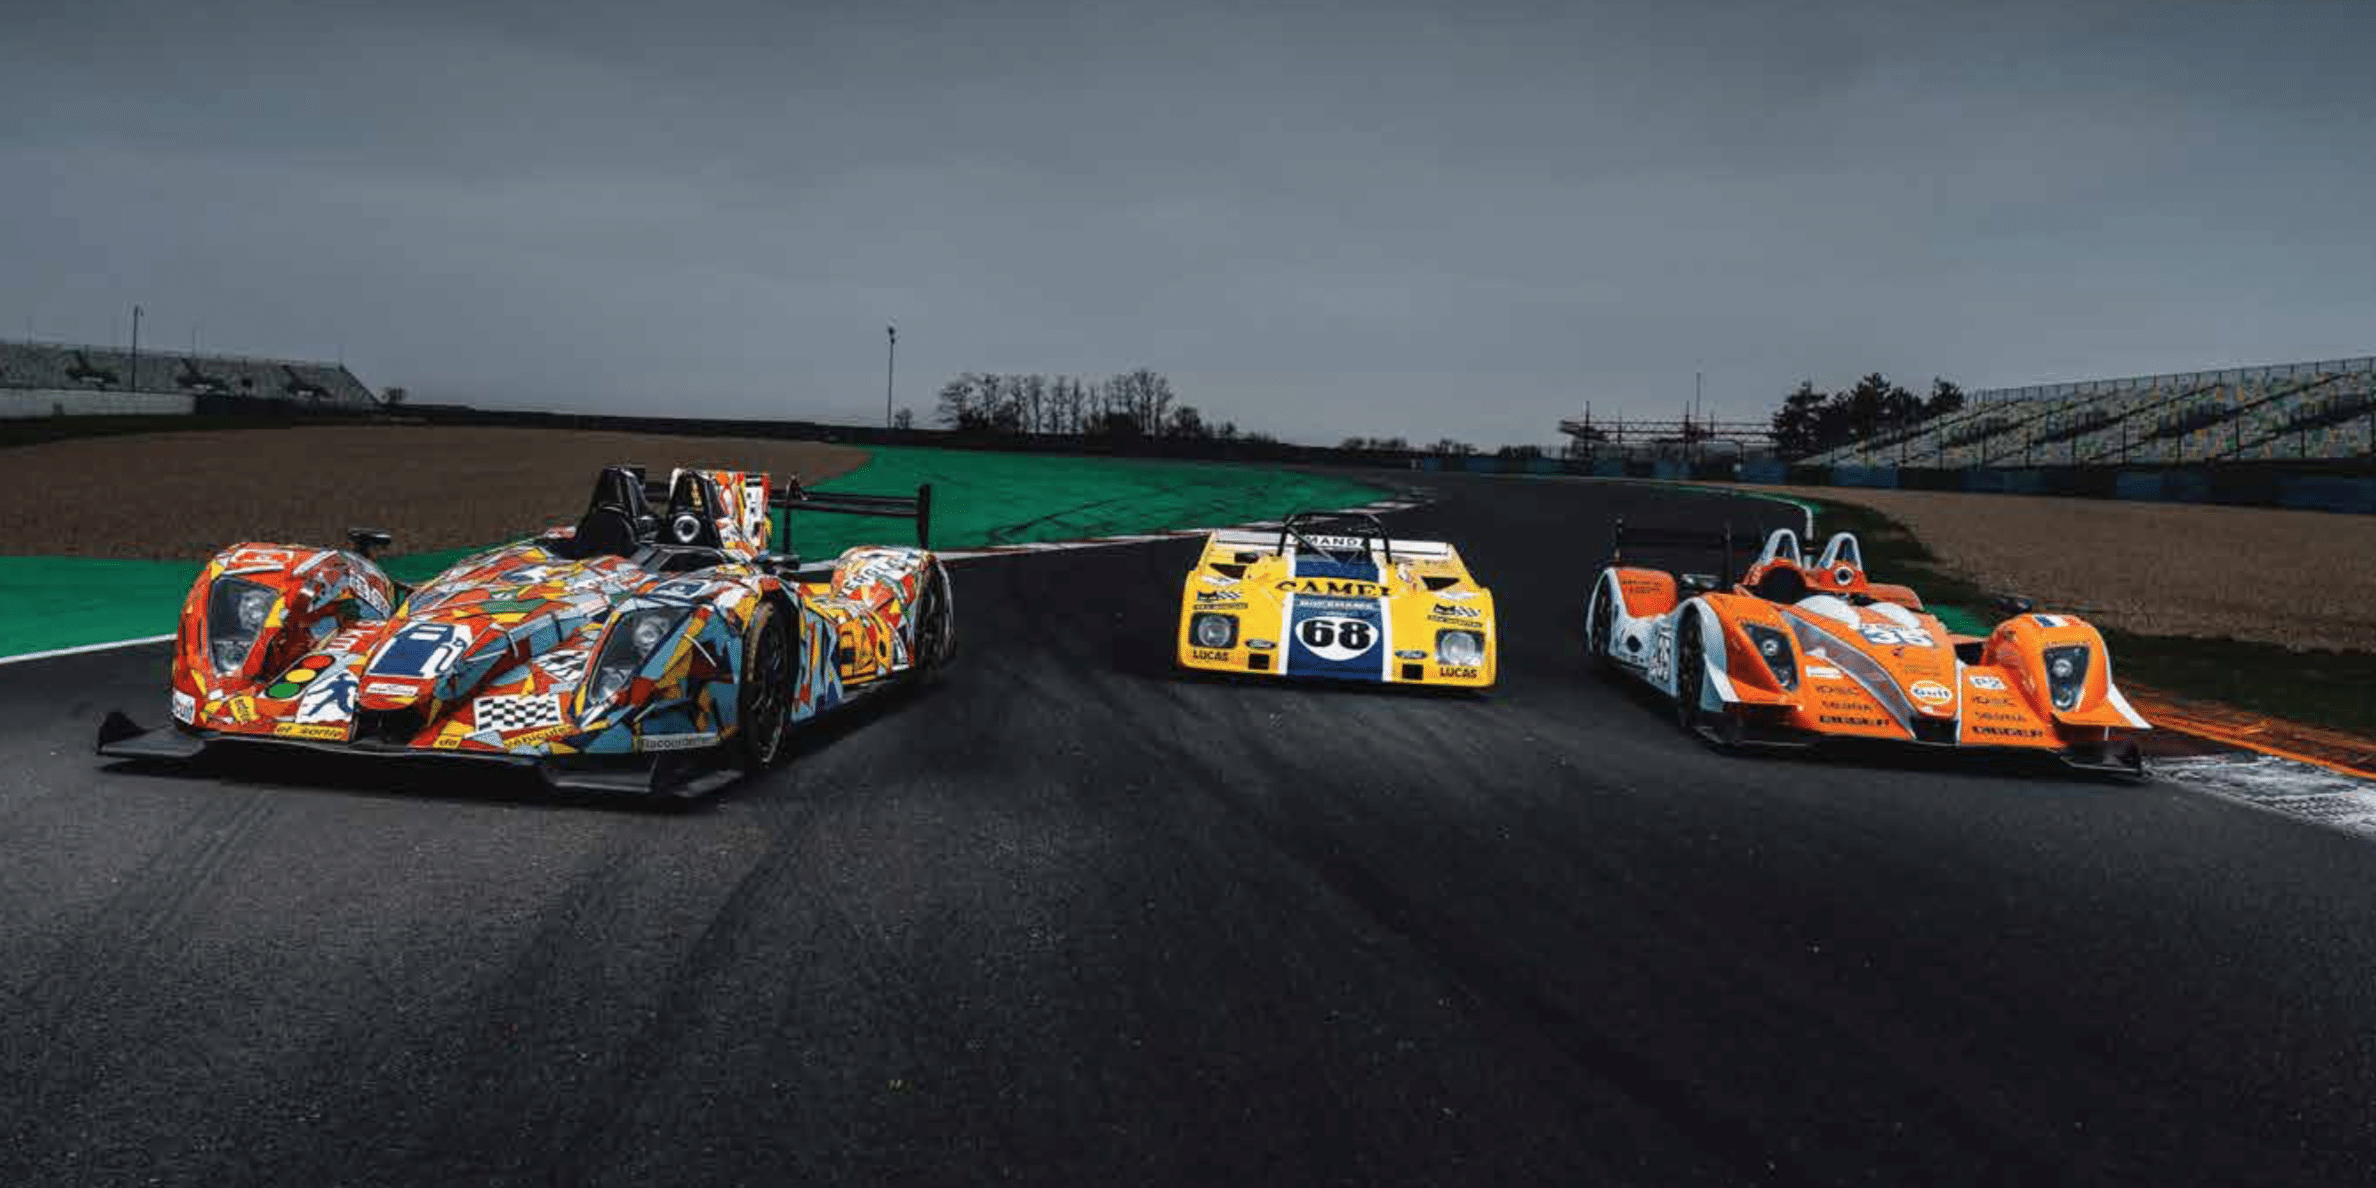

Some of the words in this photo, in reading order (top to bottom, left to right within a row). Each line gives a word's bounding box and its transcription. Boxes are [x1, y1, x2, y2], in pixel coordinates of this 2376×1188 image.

[1274, 581, 1390, 597] CAMEL
[1303, 619, 1371, 649] 68
[1193, 650, 1229, 661] LUCAS
[1440, 667, 1478, 678] LUCAS
